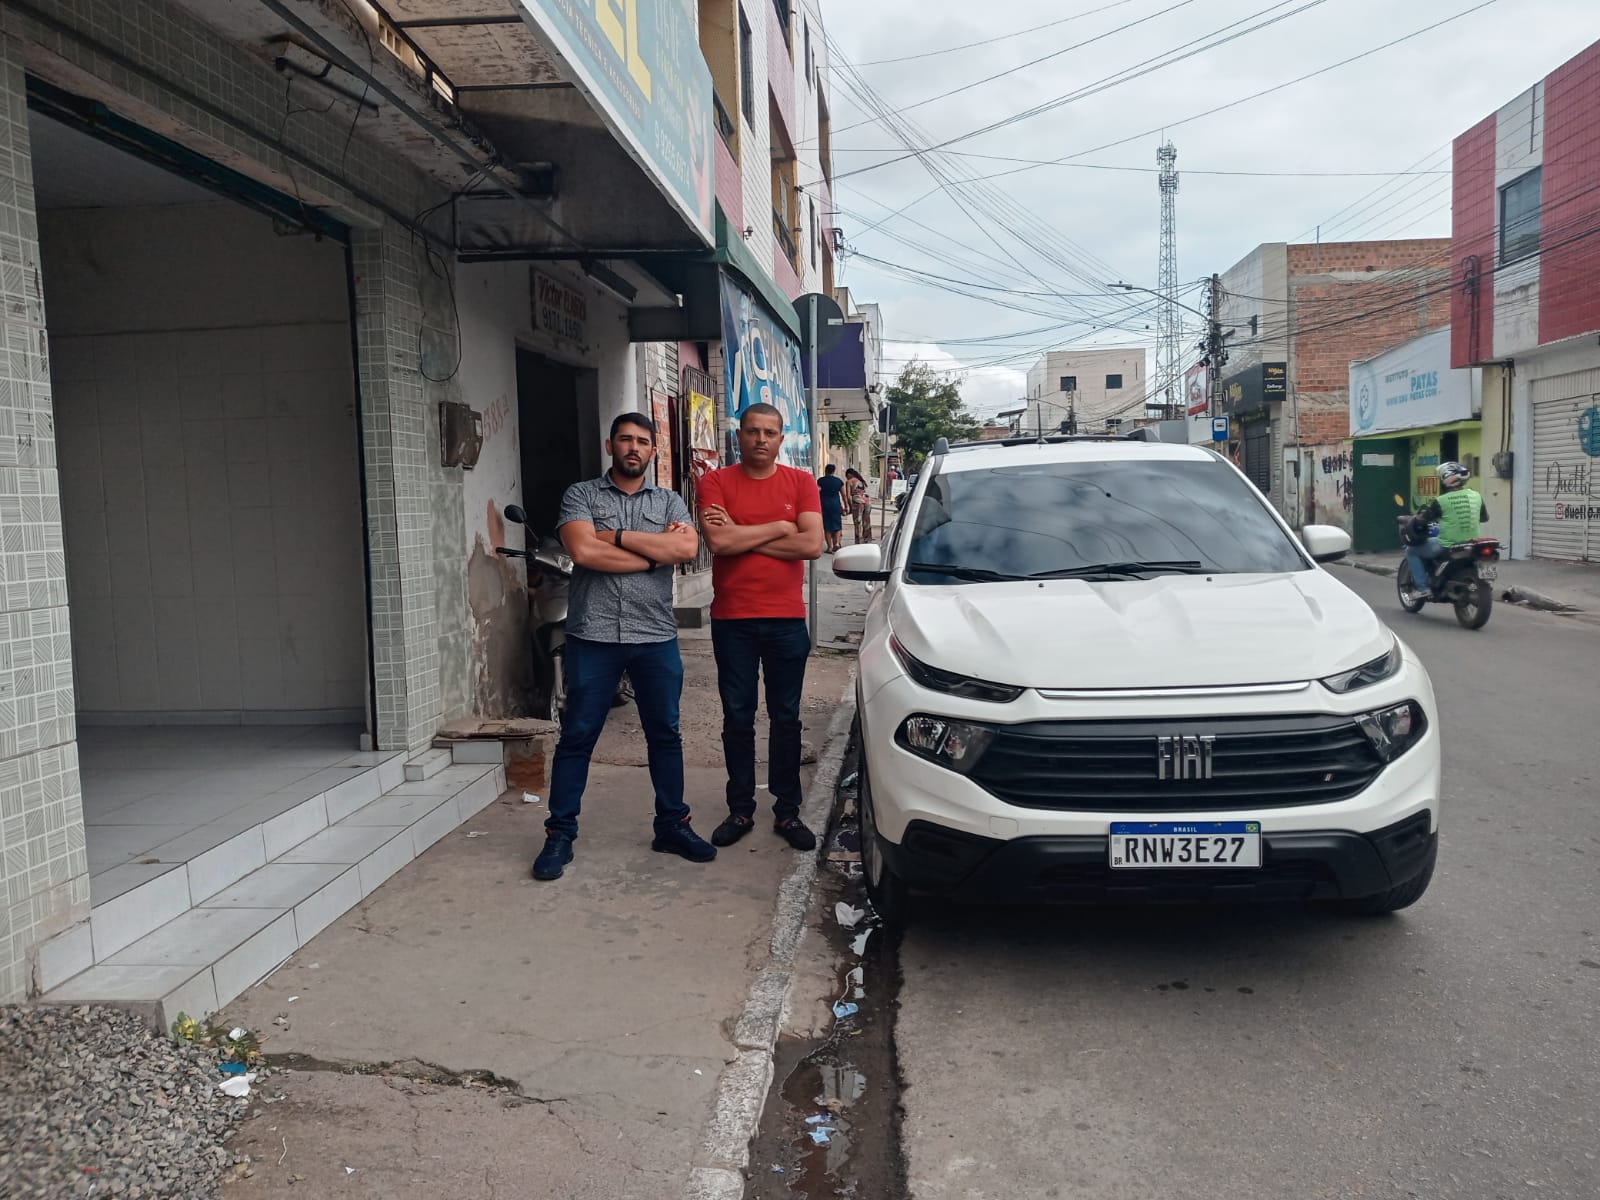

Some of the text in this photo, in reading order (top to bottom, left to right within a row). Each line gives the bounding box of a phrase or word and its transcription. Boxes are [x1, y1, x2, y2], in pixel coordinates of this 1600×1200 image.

[1158, 736, 1216, 779] FIAT
[1114, 857, 1123, 865] BR
[1125, 837, 1245, 863] RNW3E27
